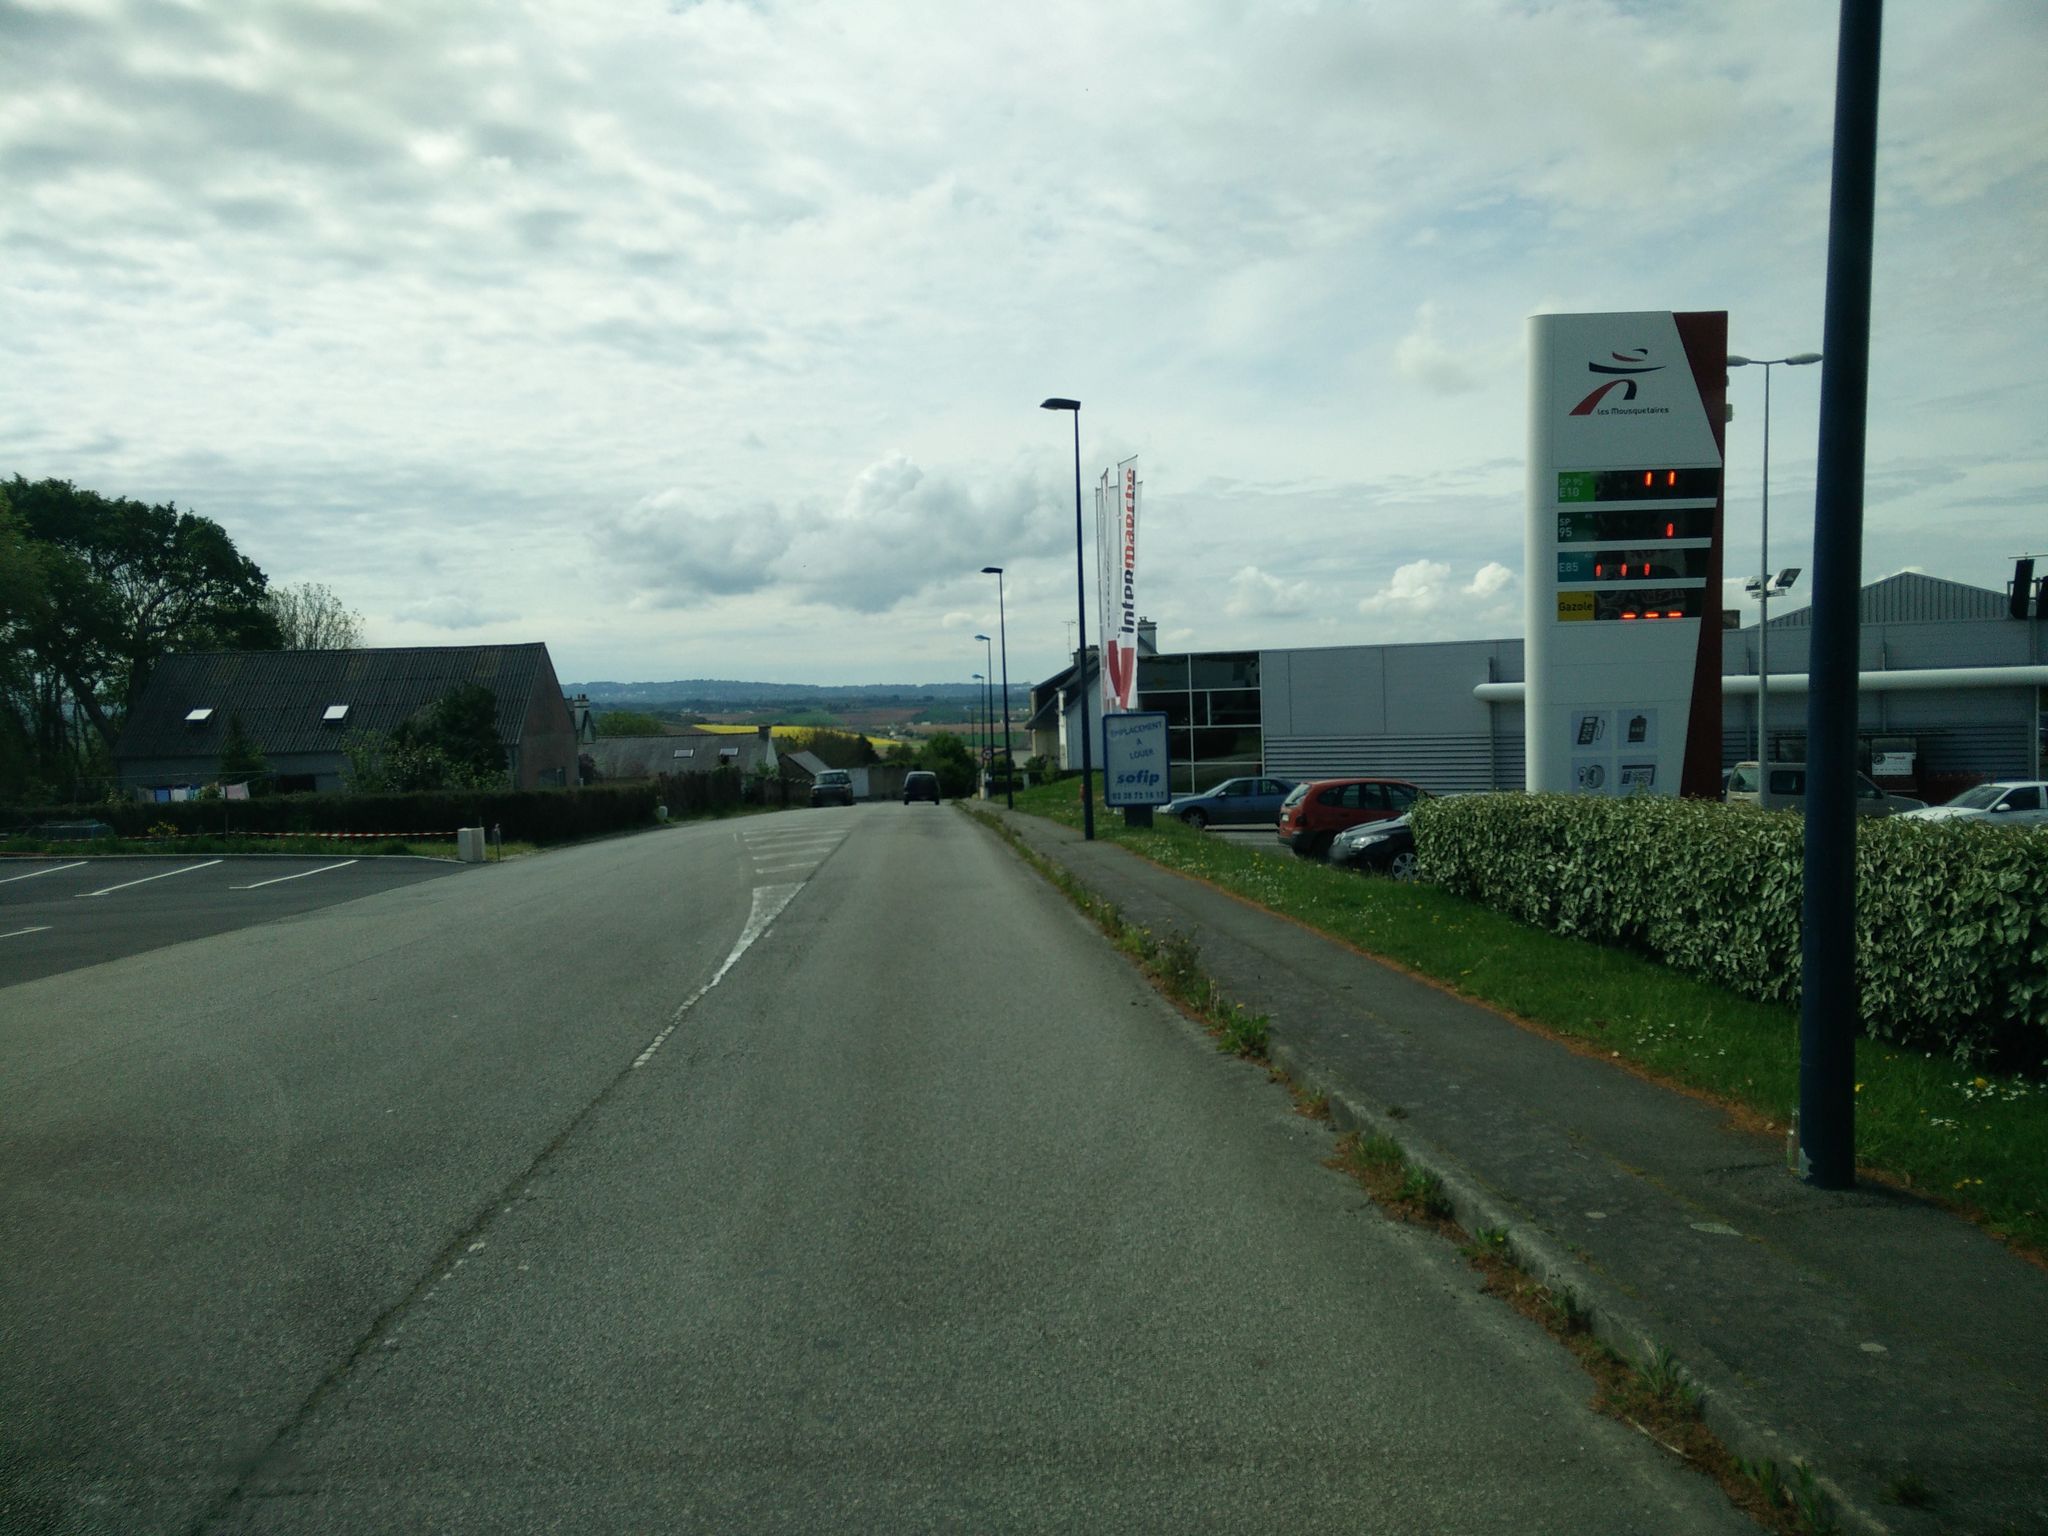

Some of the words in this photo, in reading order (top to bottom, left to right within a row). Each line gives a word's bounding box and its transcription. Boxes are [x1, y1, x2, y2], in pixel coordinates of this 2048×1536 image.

[1559, 518, 1571, 527] SP
[1559, 526, 1573, 537] 95
[1559, 561, 1579, 573] E85
[1559, 601, 1593, 612] Gazole
[1117, 769, 1160, 786] sofip
